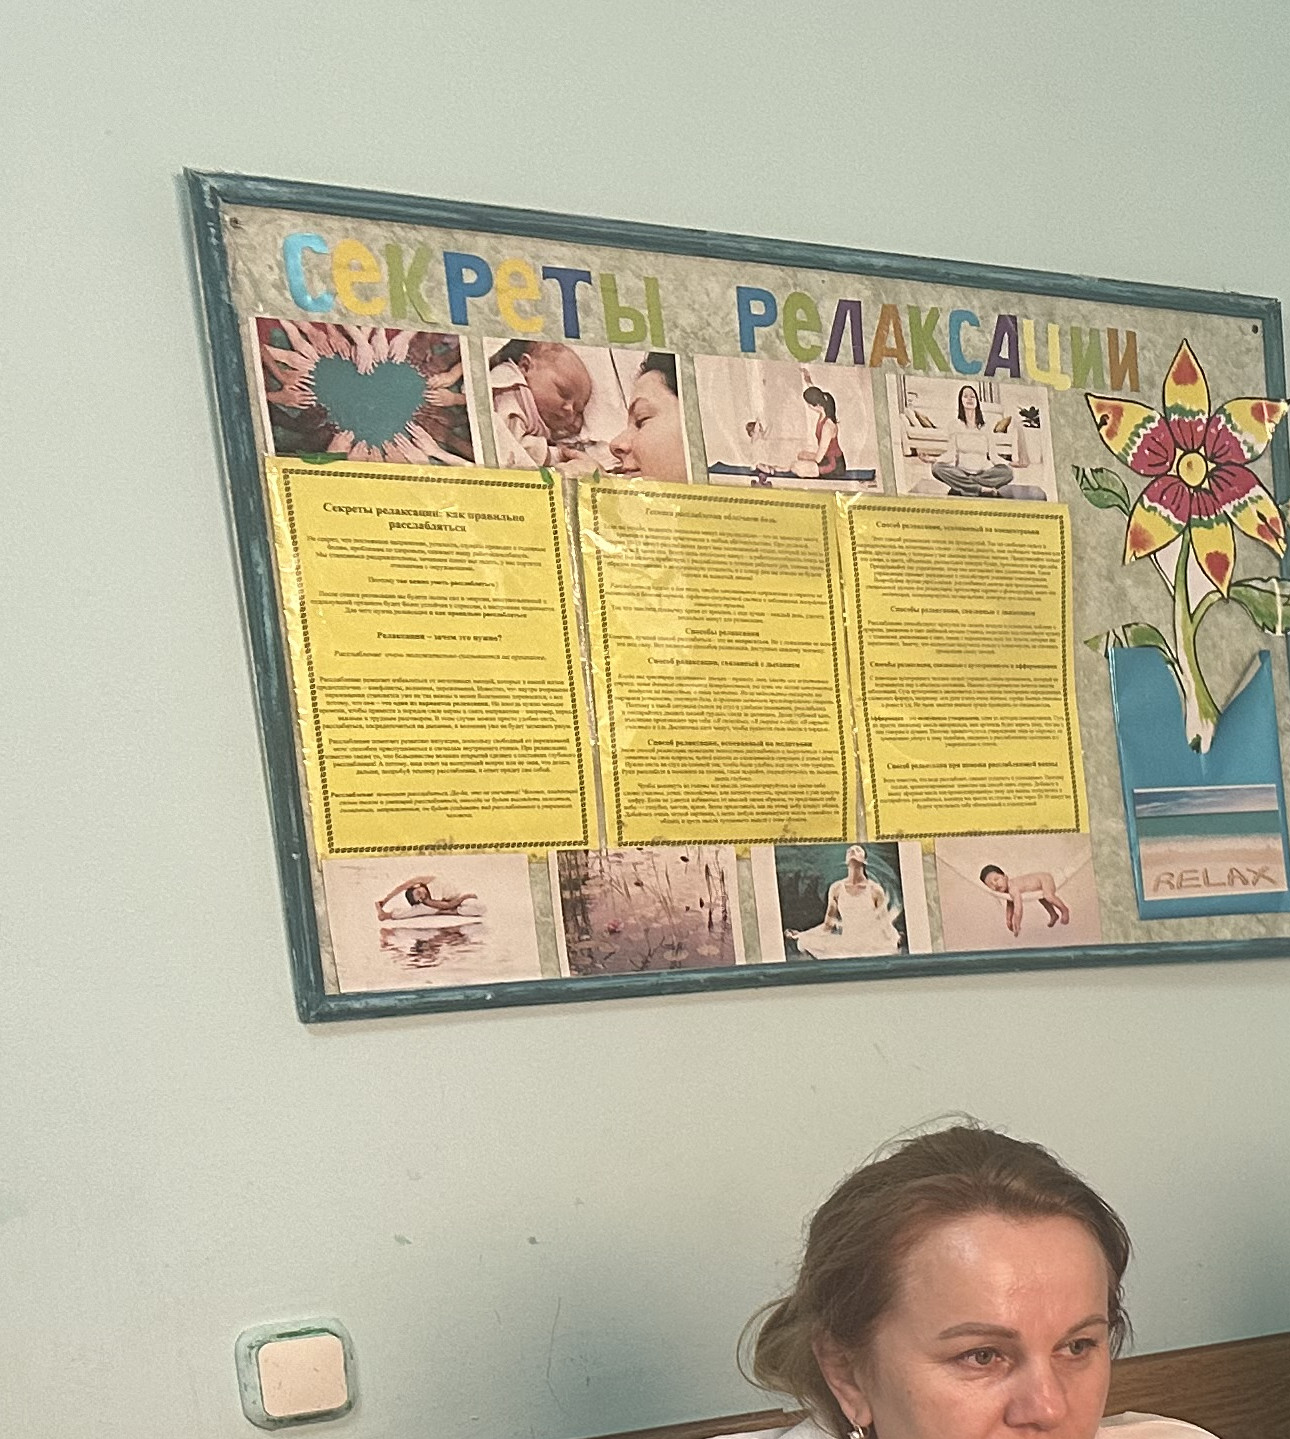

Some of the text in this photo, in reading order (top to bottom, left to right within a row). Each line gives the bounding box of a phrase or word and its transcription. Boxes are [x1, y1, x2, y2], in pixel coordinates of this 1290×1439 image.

[322, 501, 525, 523] Секреты релаксации: как правильно
[388, 519, 466, 533] расслабляться
[1150, 863, 1278, 894] RELAX
